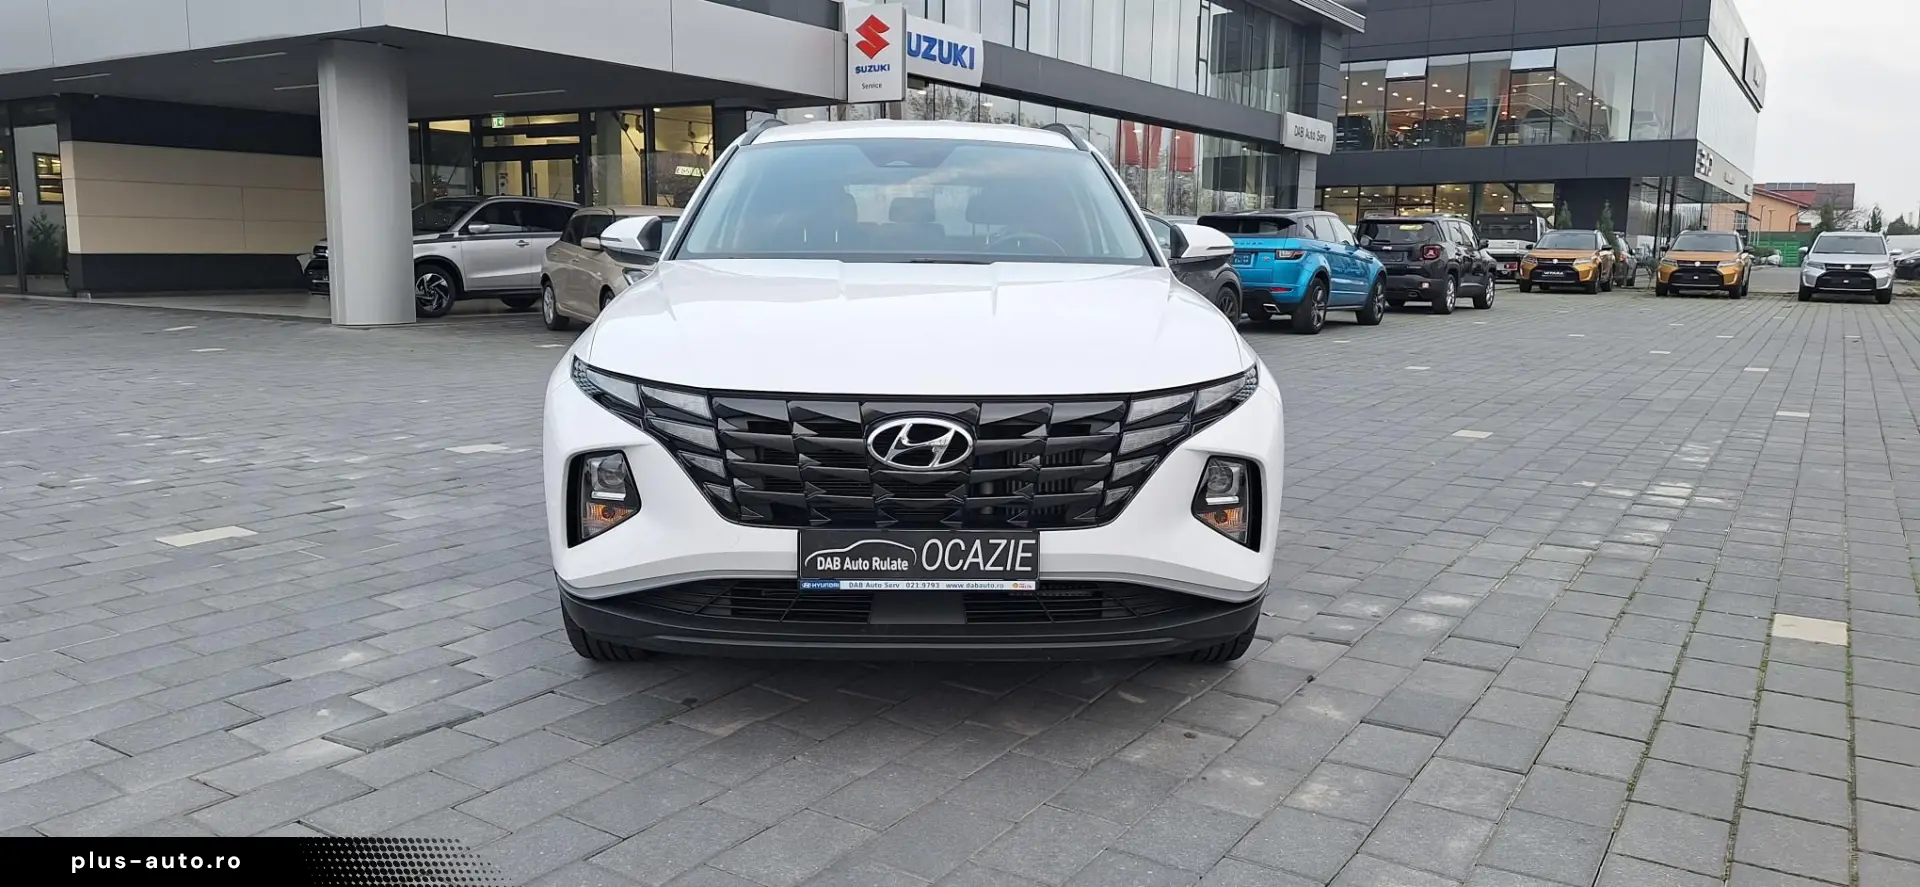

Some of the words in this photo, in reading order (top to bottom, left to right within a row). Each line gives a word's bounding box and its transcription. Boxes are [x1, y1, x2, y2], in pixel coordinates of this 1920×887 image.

[906, 31, 975, 70] UZUKI
[855, 64, 890, 74] SUZUKI
[861, 82, 882, 90] Service
[1294, 125, 1304, 138] DAB
[1305, 128, 1316, 140] Auto
[1316, 130, 1327, 143] Serv
[921, 538, 1036, 572] OCAZIE
[816, 556, 841, 571] DAB
[843, 556, 870, 571] Auto
[872, 556, 909, 571] Rulate
[945, 582, 1005, 590] www.dabauto.ro
